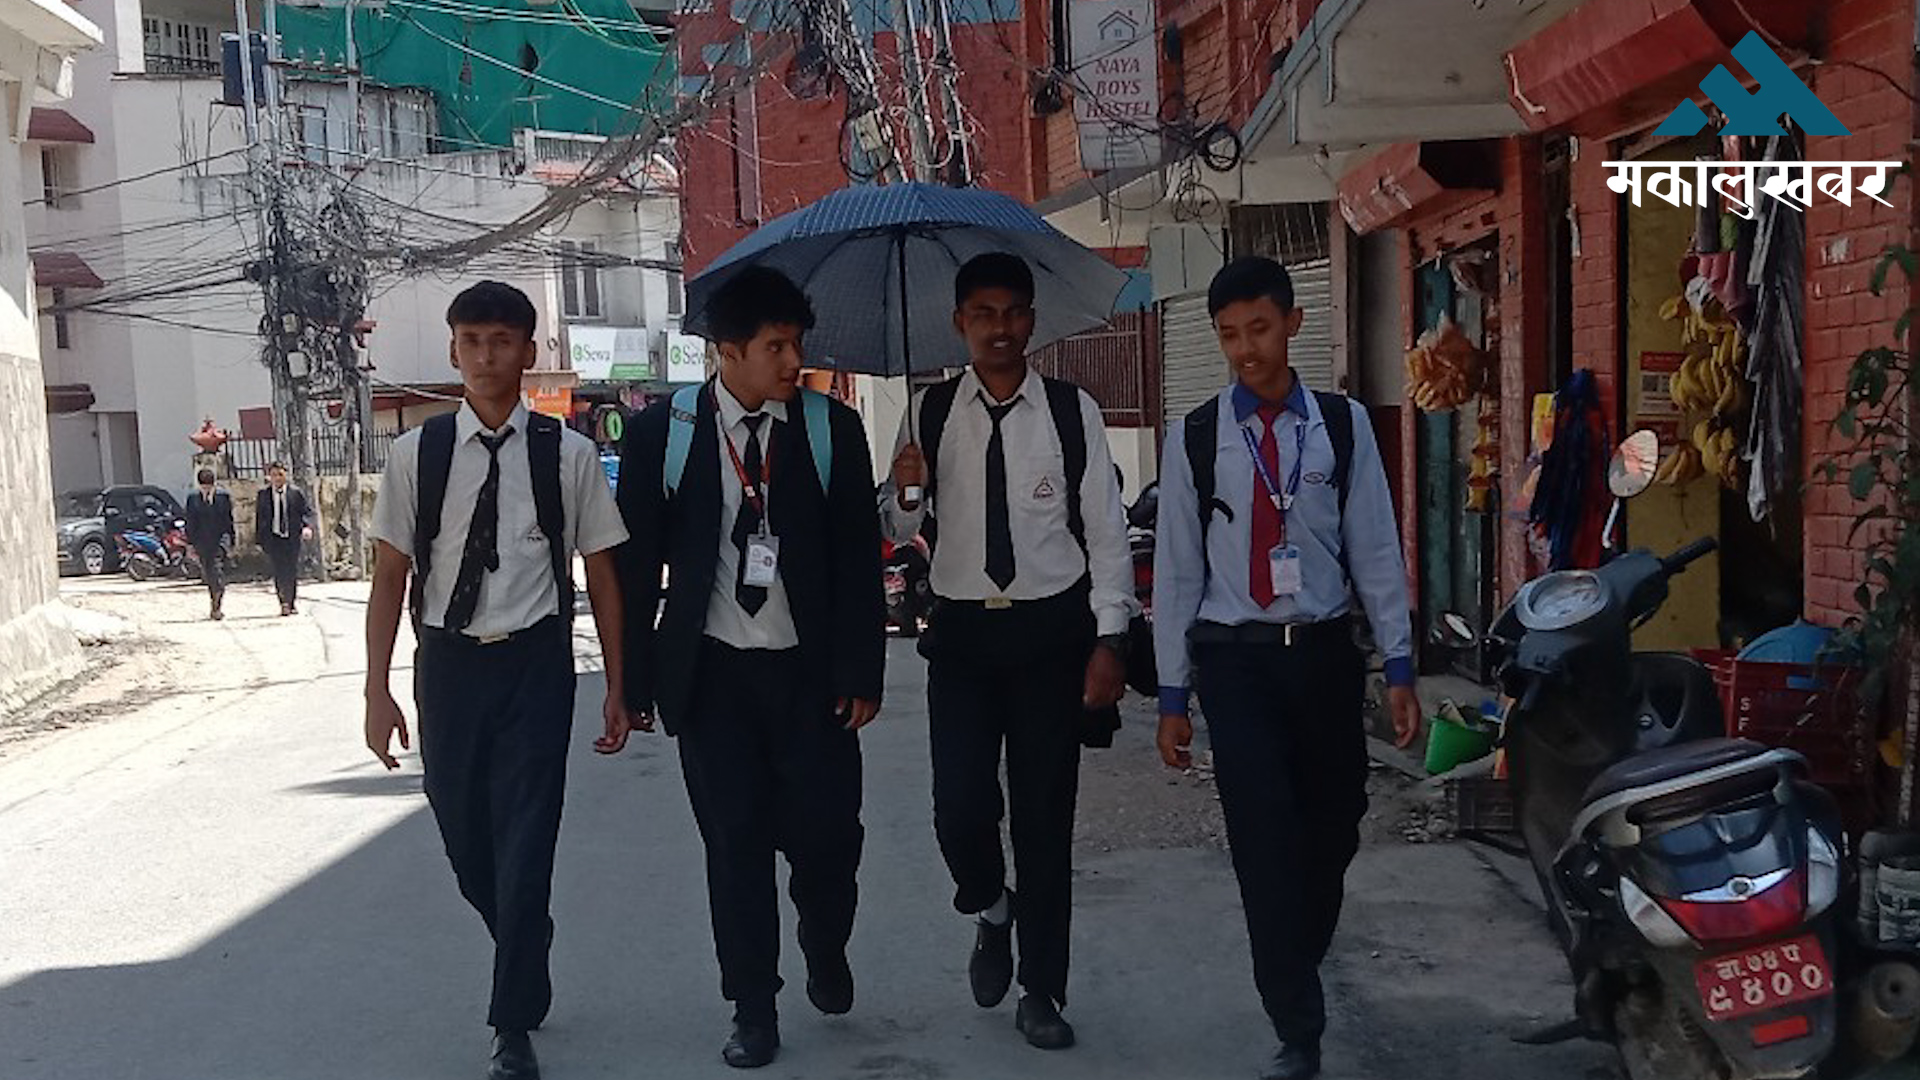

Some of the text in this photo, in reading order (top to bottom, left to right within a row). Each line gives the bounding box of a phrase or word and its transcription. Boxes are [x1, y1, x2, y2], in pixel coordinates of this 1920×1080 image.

[1095, 59, 1140, 74] NAYA
[1096, 80, 1140, 96] BOYS
[1086, 101, 1152, 118] HOSTEL
